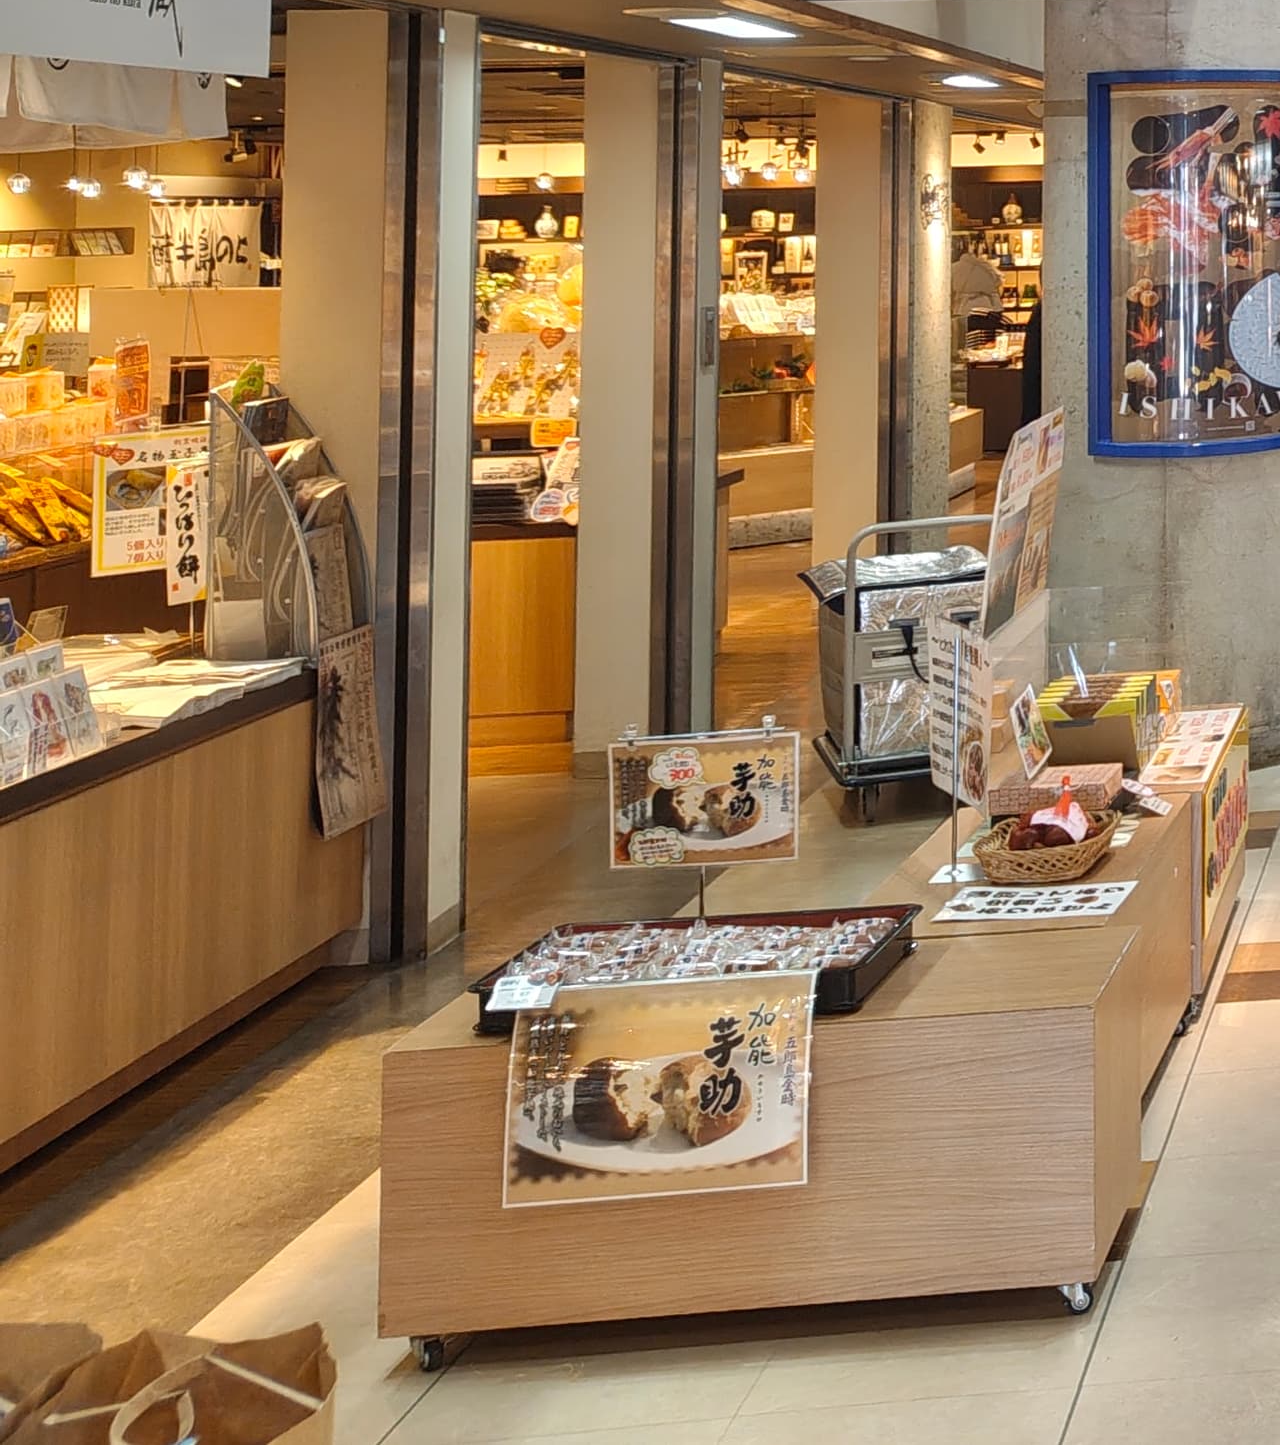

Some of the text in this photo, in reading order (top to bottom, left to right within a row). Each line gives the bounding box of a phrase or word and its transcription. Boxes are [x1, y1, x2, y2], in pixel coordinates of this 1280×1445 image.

[126, 538, 165, 552] 5個入り
[127, 550, 165, 564] 7個入り
[173, 485, 199, 584] ひっぱり餅
[728, 762, 755, 819] 芋助
[756, 753, 777, 791] 加能
[747, 1003, 777, 1066] 加能
[699, 1017, 745, 1115] 芋助
[779, 1035, 797, 1106] 五郎島金時
